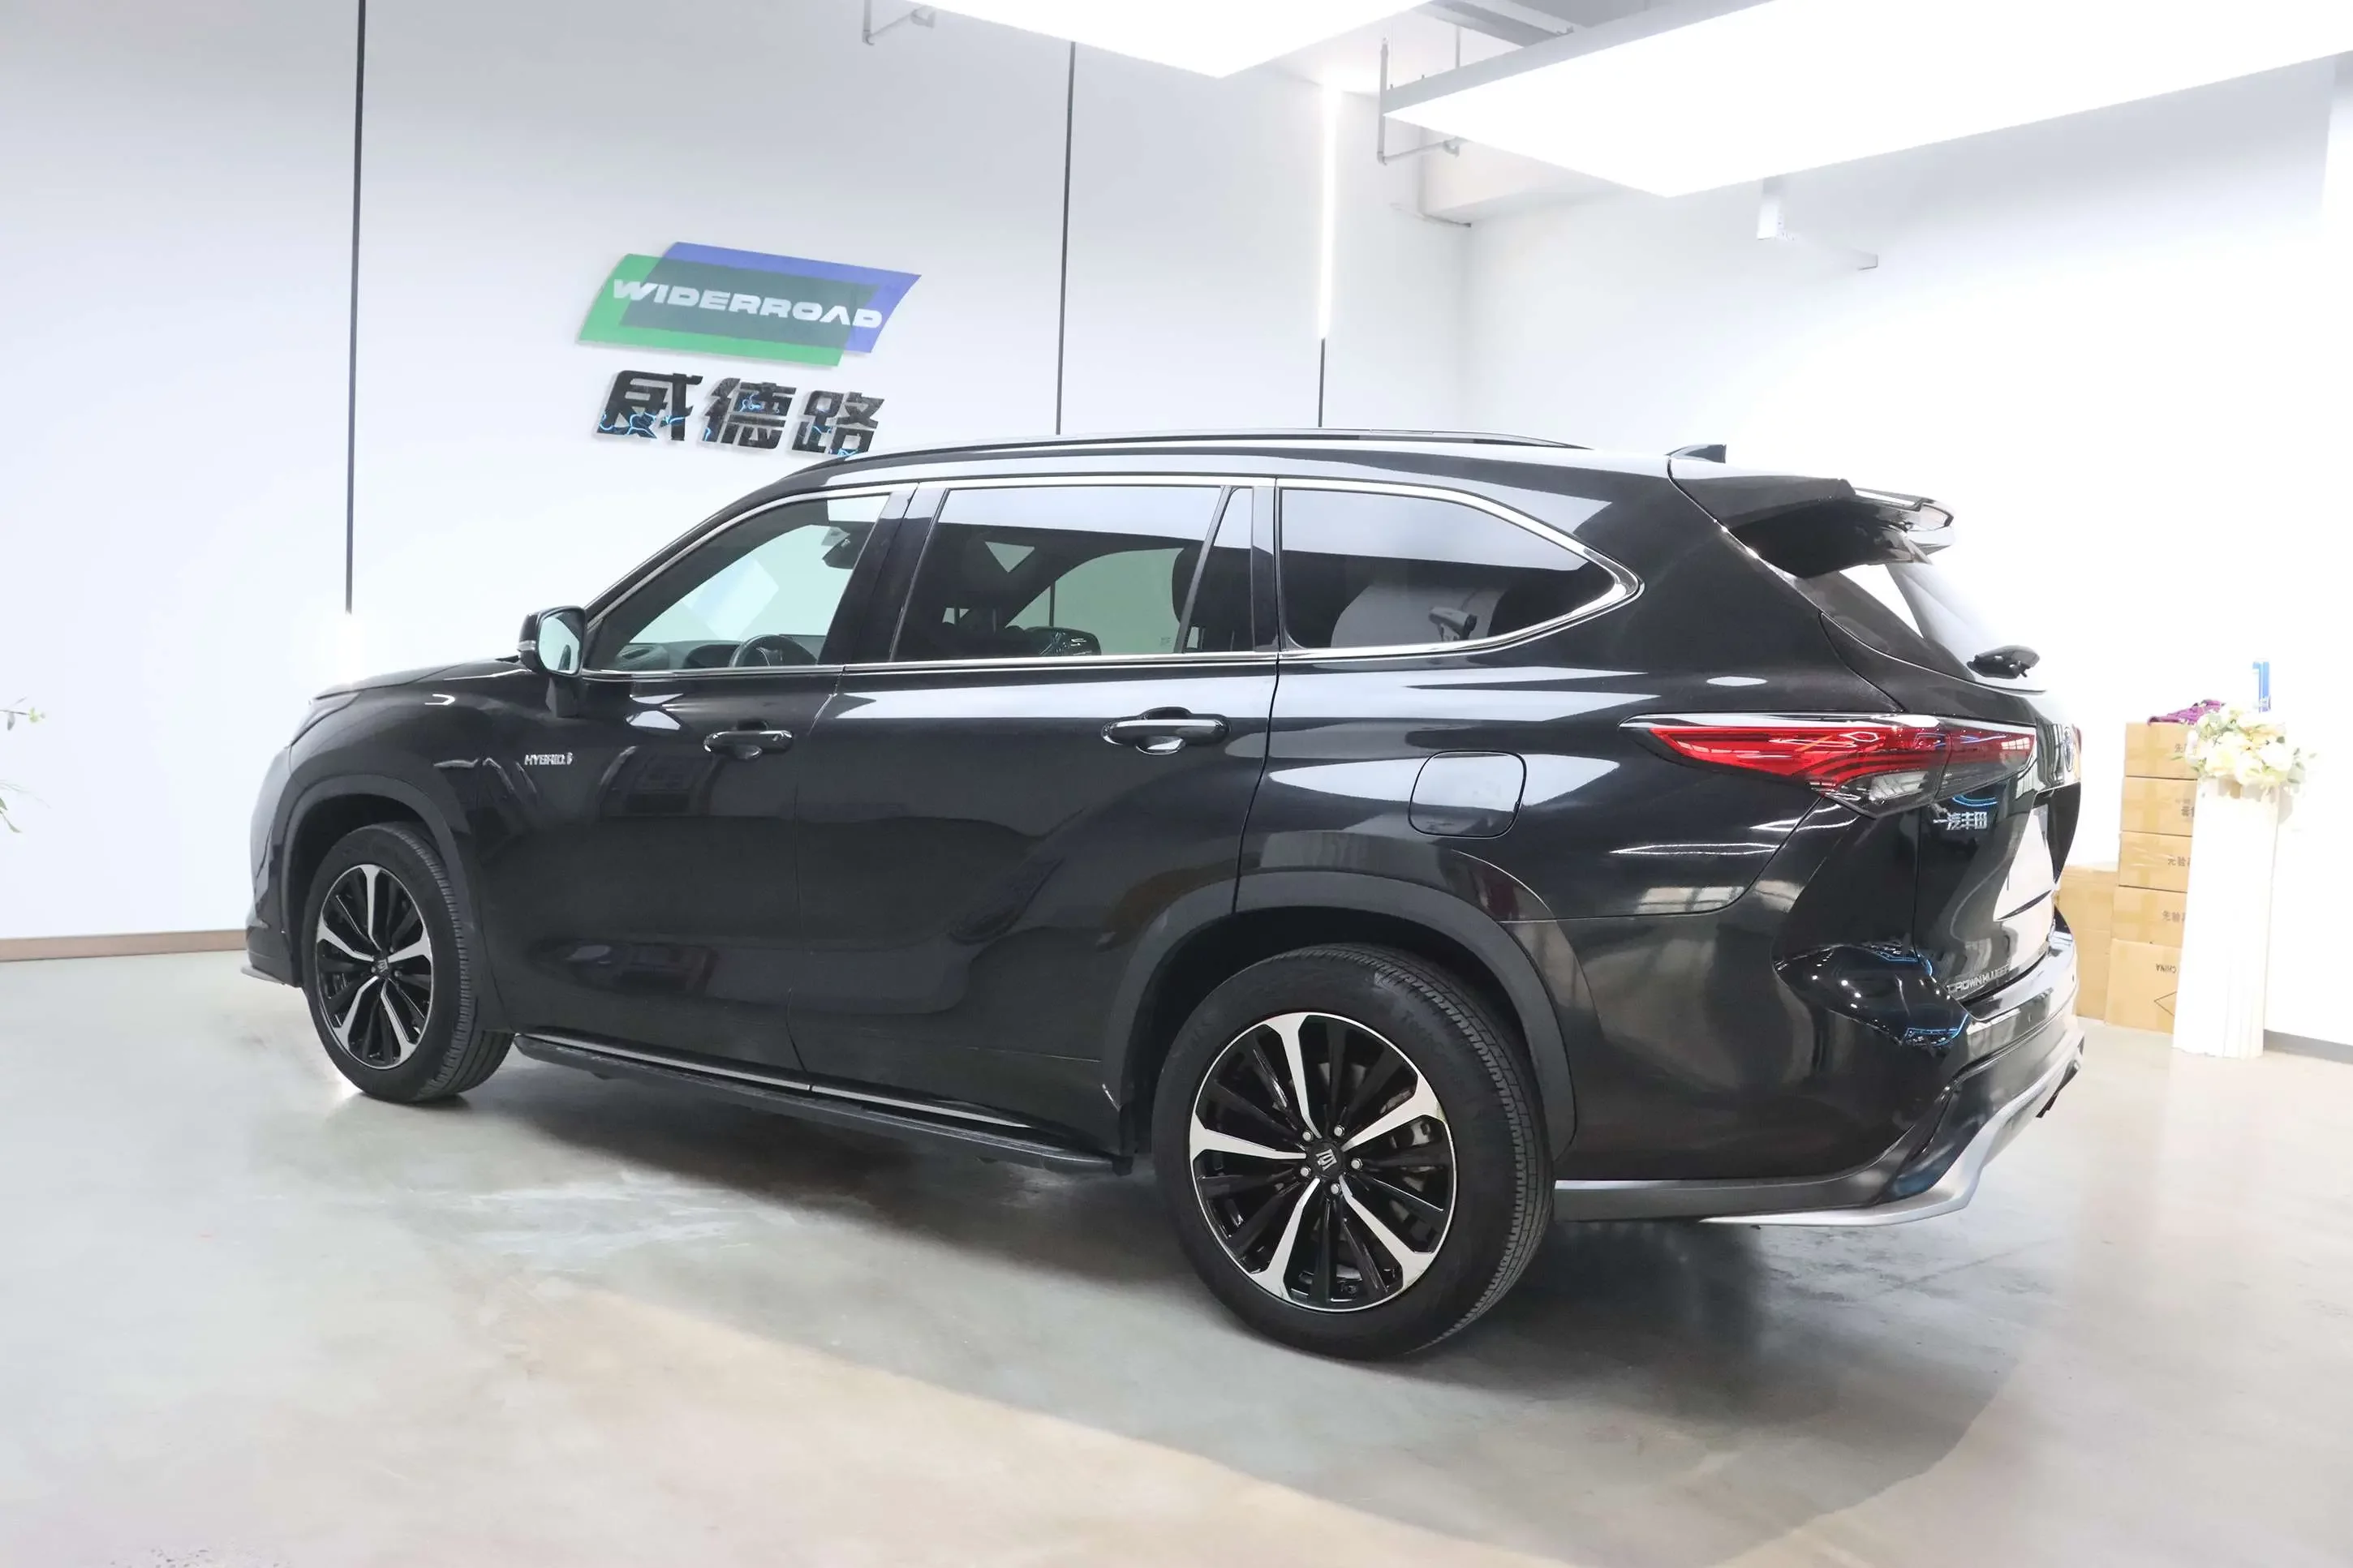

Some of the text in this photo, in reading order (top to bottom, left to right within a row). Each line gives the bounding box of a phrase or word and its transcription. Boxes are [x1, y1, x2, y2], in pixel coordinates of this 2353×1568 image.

[613, 278, 883, 329] WIDERROAD
[596, 369, 885, 458] 威德路
[1933, 811, 1988, 831] 一汽丰田
[1946, 976, 1982, 994] CROWN
